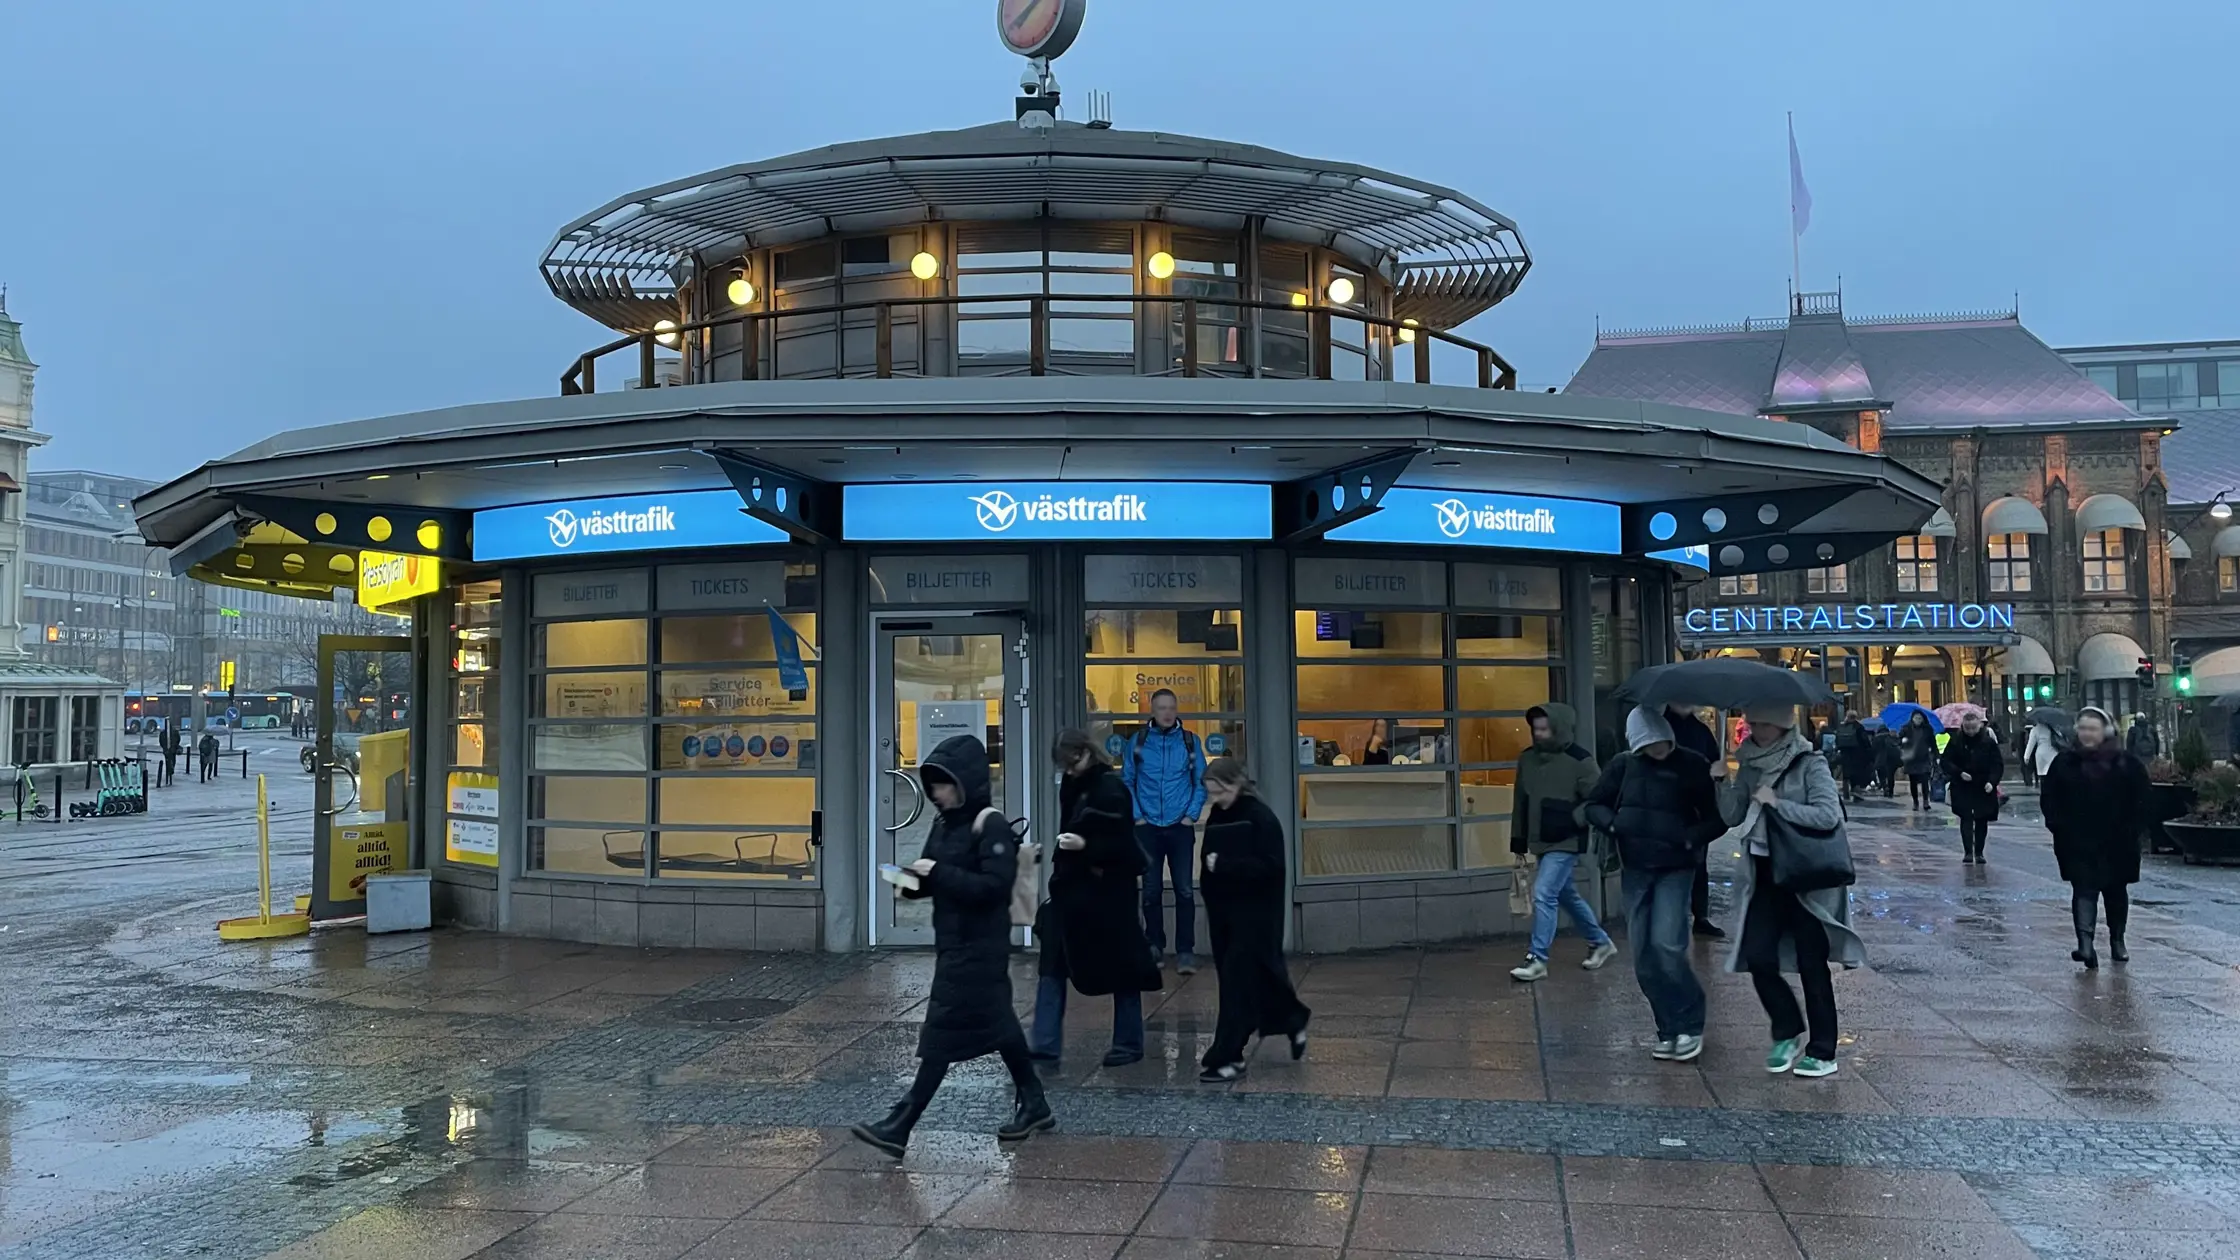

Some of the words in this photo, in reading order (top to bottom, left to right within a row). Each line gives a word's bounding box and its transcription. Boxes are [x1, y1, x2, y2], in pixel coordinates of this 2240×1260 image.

[1023, 494, 1147, 521] västtrafik
[580, 505, 676, 537] västtrafik
[1473, 504, 1556, 534] västtrafik
[690, 578, 749, 596] TICKETS
[906, 571, 992, 589] BILJETTER
[1130, 571, 1197, 589] TICKETS
[1334, 574, 1406, 592] BILJETTER
[563, 583, 618, 602] BILJETTER
[1685, 603, 2013, 633] CENTRALSTATION
[709, 676, 762, 690] Service
[1135, 673, 1196, 687] Service
[1129, 691, 1138, 704] &
[357, 840, 390, 854] alltid,
[355, 854, 391, 869] alltid!
